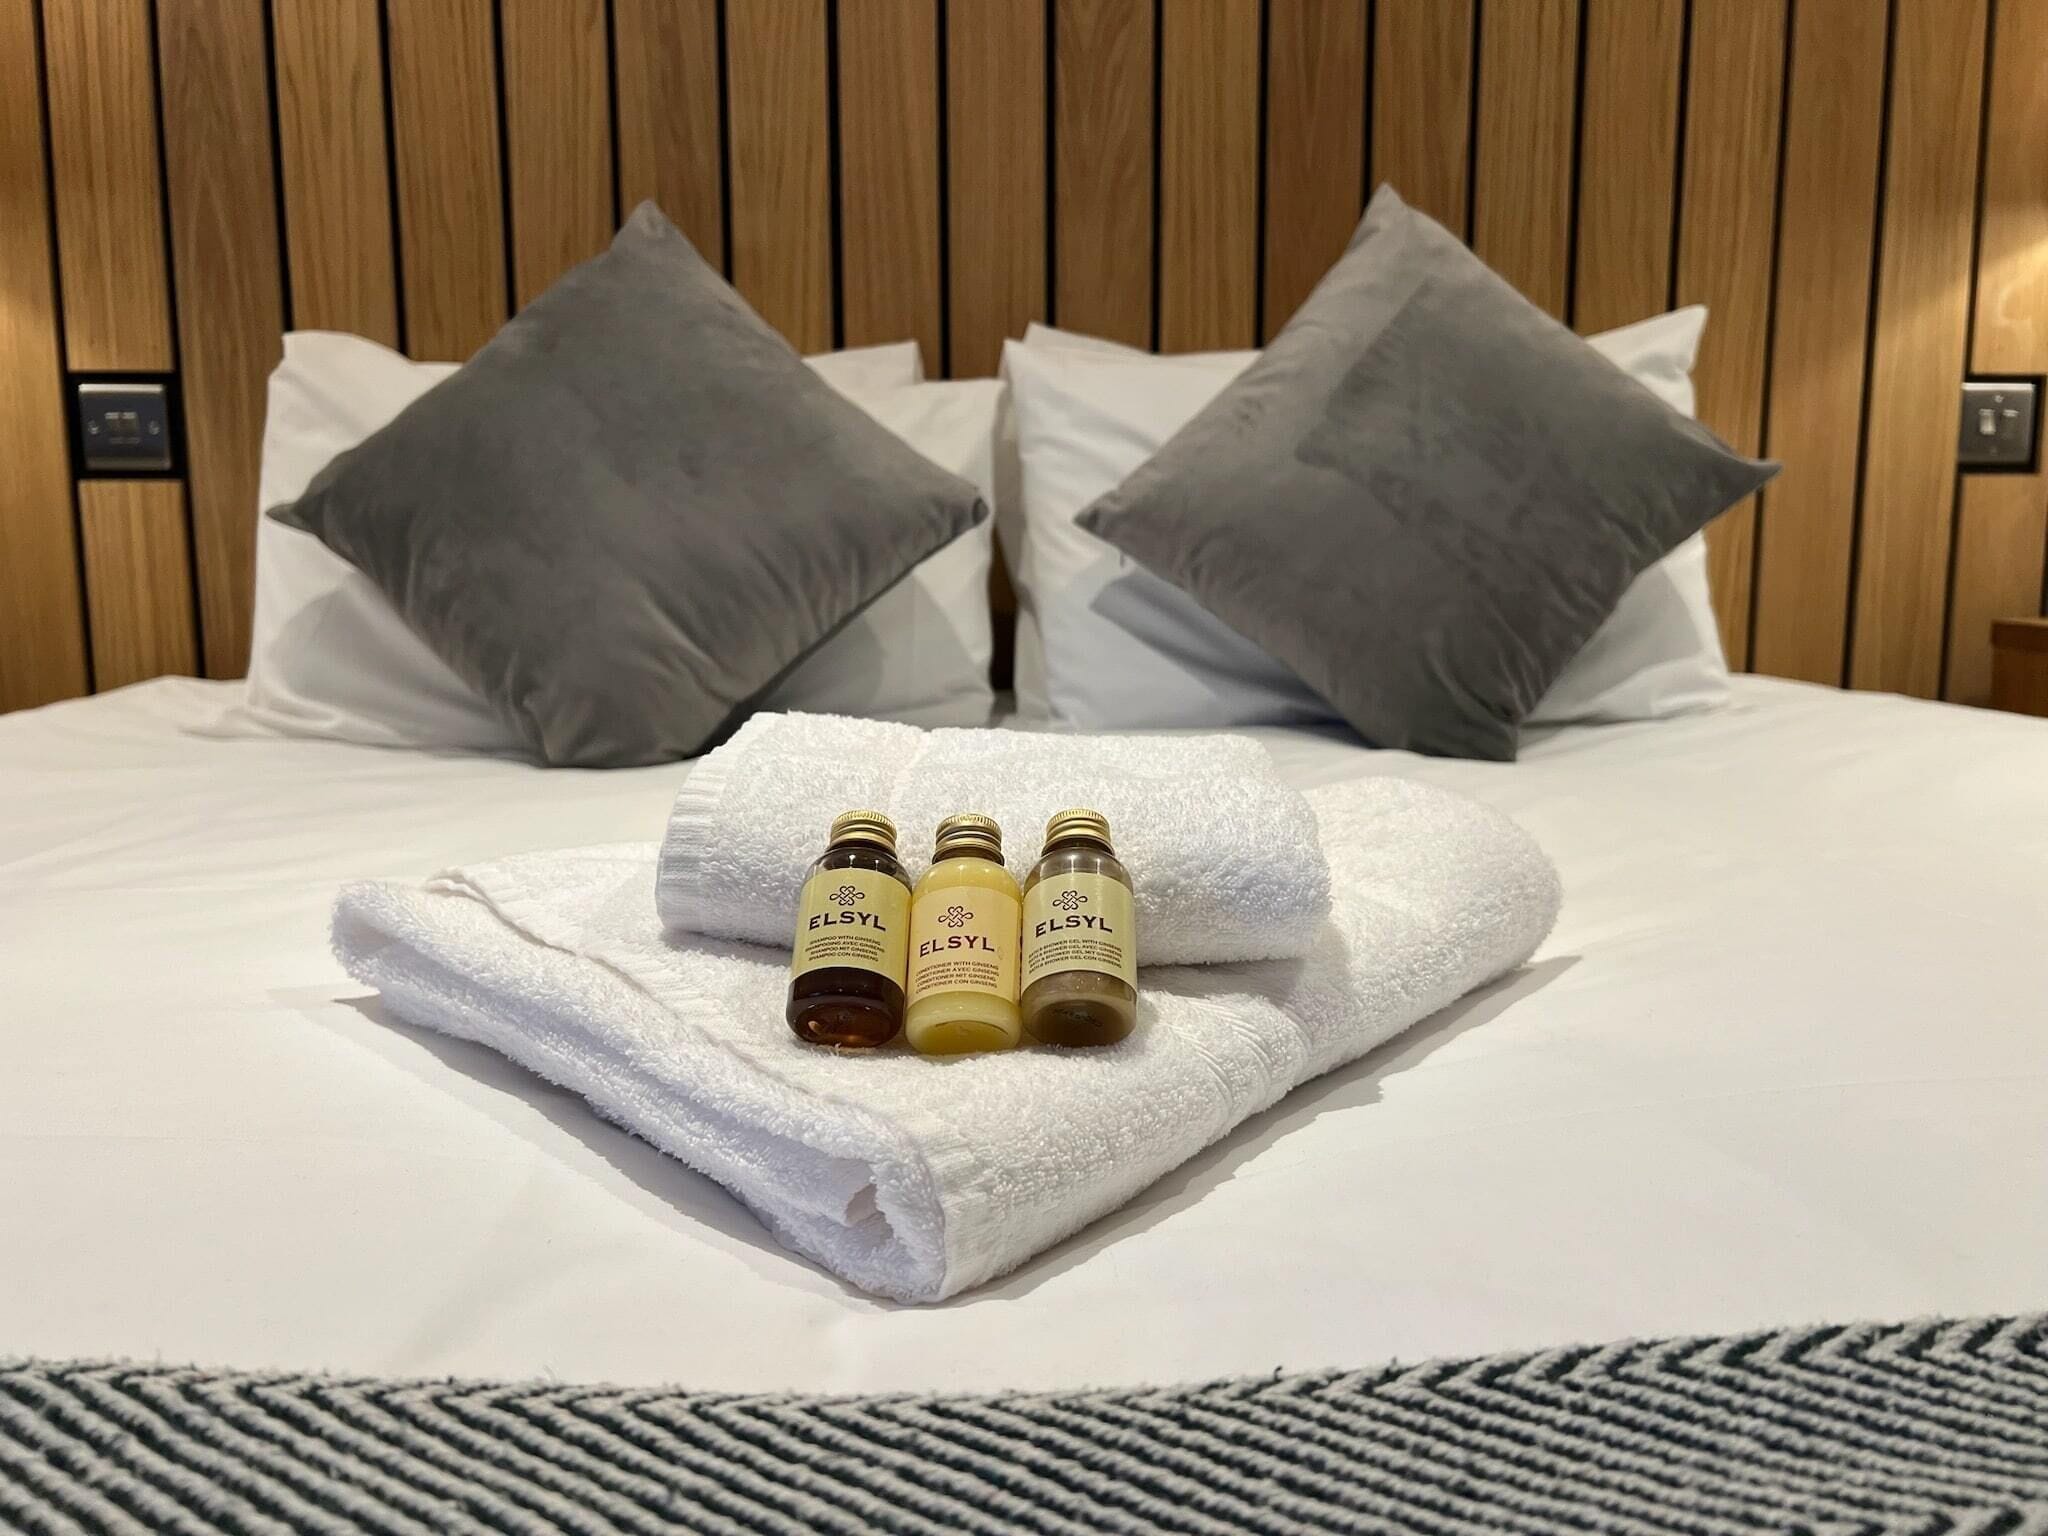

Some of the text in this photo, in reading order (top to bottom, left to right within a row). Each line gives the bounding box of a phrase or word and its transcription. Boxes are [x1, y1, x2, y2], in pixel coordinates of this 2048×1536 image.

[809, 911, 886, 931] ELSYL
[1036, 915, 1112, 938] ELSYL
[810, 936, 837, 944] SHAMPOO
[855, 936, 880, 945] GINSENG
[1044, 940, 1068, 949] SHOWER
[810, 947, 838, 955] SHAMPOO
[851, 947, 878, 956] GINSENG
[860, 943, 885, 953] GINSENG
[920, 936, 994, 958] ELSYL
[1044, 945, 1067, 954] SHOWER
[808, 952, 836, 961] SHAMPOO
[852, 952, 878, 962] GINSENG
[1046, 950, 1070, 959] SHOWER
[1045, 955, 1069, 965] SHOWER
[916, 962, 951, 976] CONDITIONER
[972, 961, 999, 970] GINSENG
[916, 968, 950, 982] CONDITIONER
[972, 968, 999, 976] GINSENG
[917, 974, 954, 987] CONDITIONER
[968, 973, 997, 981] GINSENG
[916, 980, 953, 994] CONDITIONER
[970, 980, 997, 988] GINSENG
